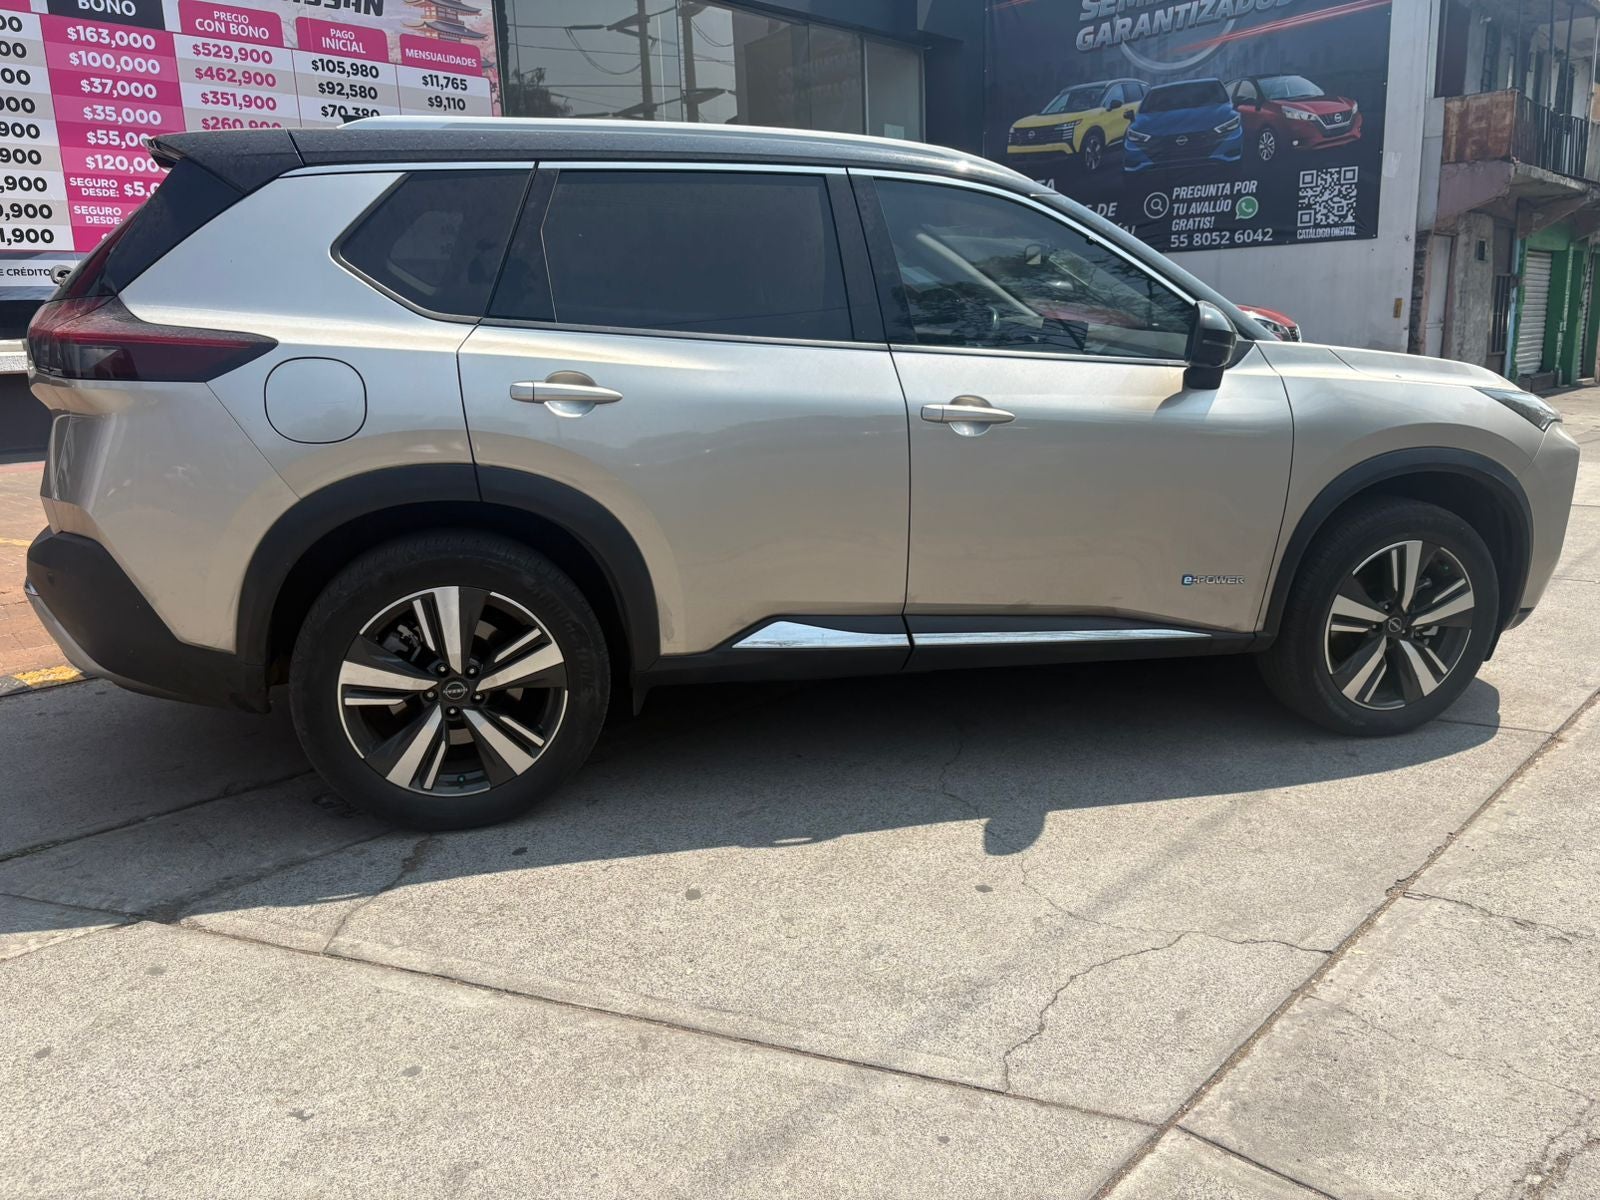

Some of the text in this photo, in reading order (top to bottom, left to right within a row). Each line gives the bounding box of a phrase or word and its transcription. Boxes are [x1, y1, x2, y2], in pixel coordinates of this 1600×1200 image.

[213, 10, 249, 24] PRECIO
[67, 25, 156, 50] $163,000
[195, 18, 270, 40] CON BONO
[330, 28, 355, 40] PAGO
[192, 42, 273, 65] $529,900
[321, 36, 367, 54] INICIAL
[69, 50, 160, 75] $100,000
[405, 48, 477, 68] MENSUALIDADES
[194, 66, 277, 88] $462,900
[311, 58, 380, 79] $105,980
[80, 77, 157, 99] $37,000
[318, 81, 378, 100] $92,580
[421, 74, 468, 91] $11,765
[200, 90, 277, 111] $351,900
[427, 95, 466, 111] $9,110
[83, 104, 162, 126] $35,000
[69, 177, 118, 188] SEGURO
[81, 187, 120, 198] DESDE:
[1172, 180, 1258, 200] PREGUNTA POR
[73, 205, 122, 216] SEGURO
[1173, 197, 1232, 217] TU AVALÚO
[1171, 216, 1215, 232] GRATIS!
[1297, 225, 1357, 239] CATÁLOGO DIGITAL
[1170, 227, 1273, 248] 55 8052 6042
[6, 266, 51, 278] CRÉDITO
